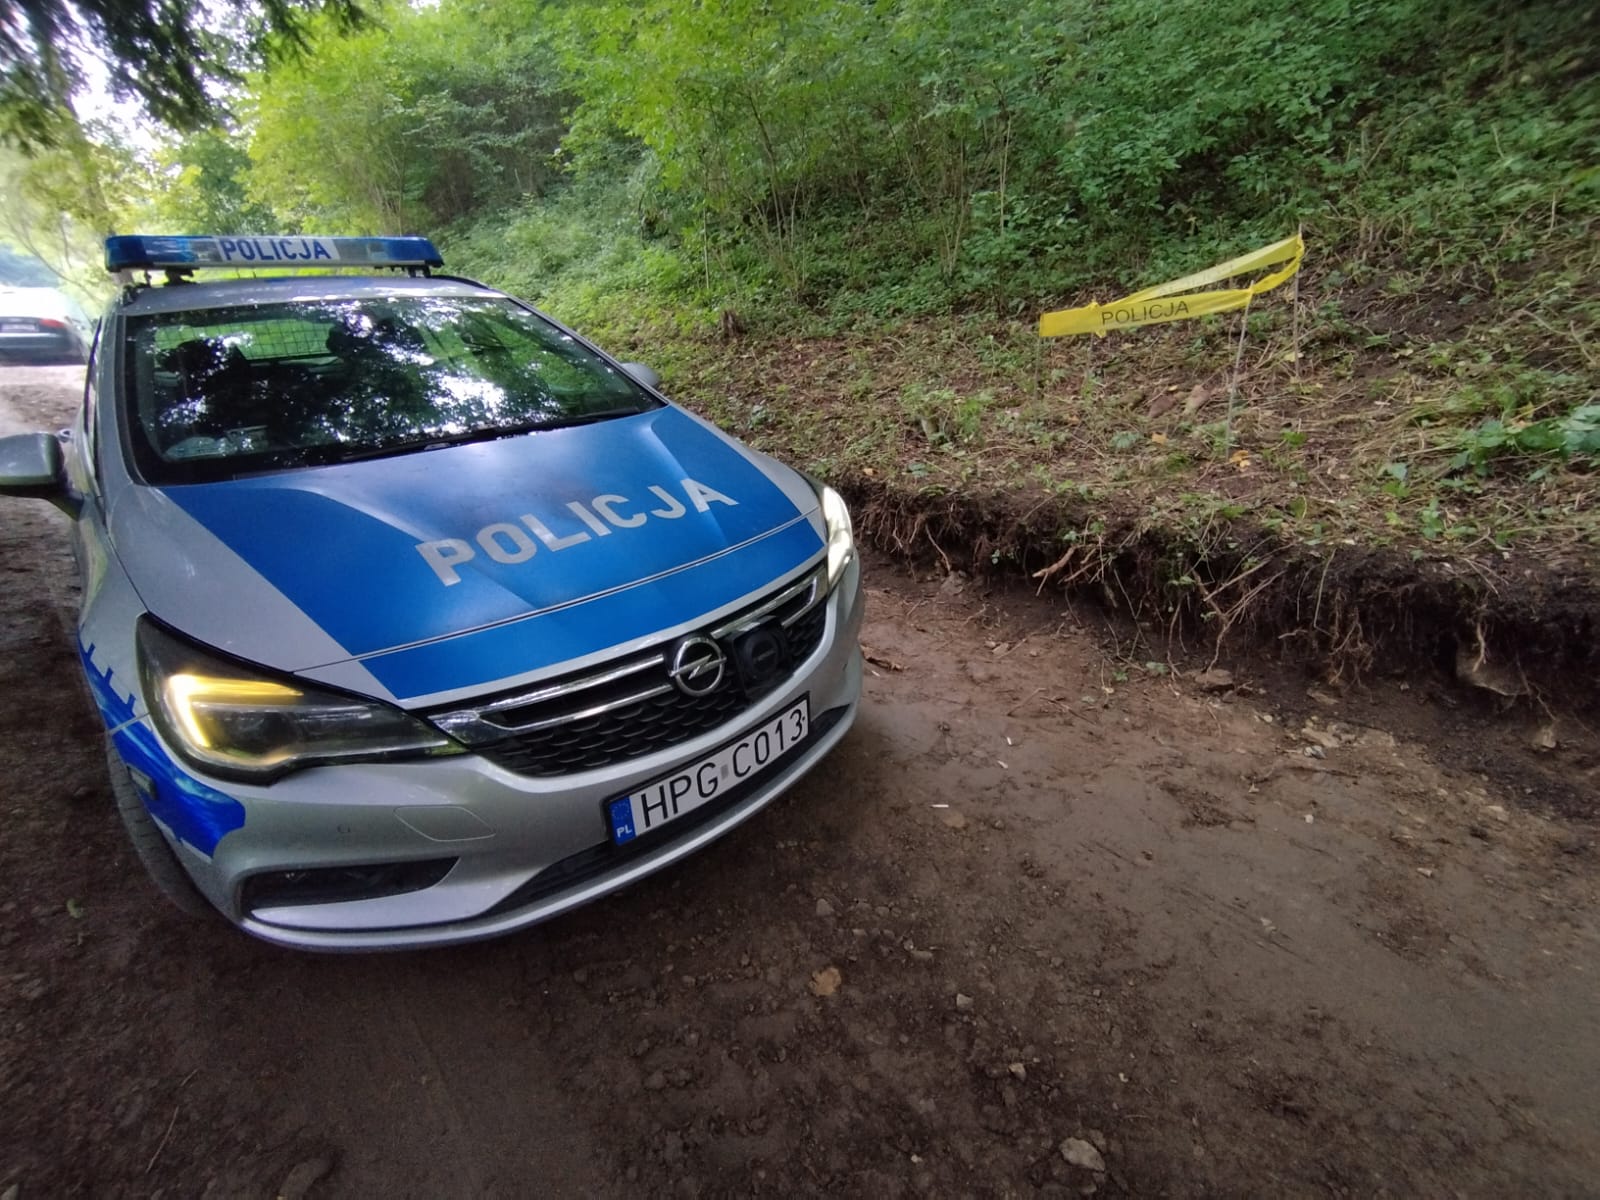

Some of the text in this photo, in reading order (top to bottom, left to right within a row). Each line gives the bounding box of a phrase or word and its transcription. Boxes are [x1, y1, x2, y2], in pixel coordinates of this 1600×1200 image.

[219, 238, 331, 261] POLICJA
[1102, 302, 1189, 325] POLICJA
[415, 478, 739, 587] POLICJA
[640, 708, 804, 828] HPG C013
[616, 824, 633, 838] PL
